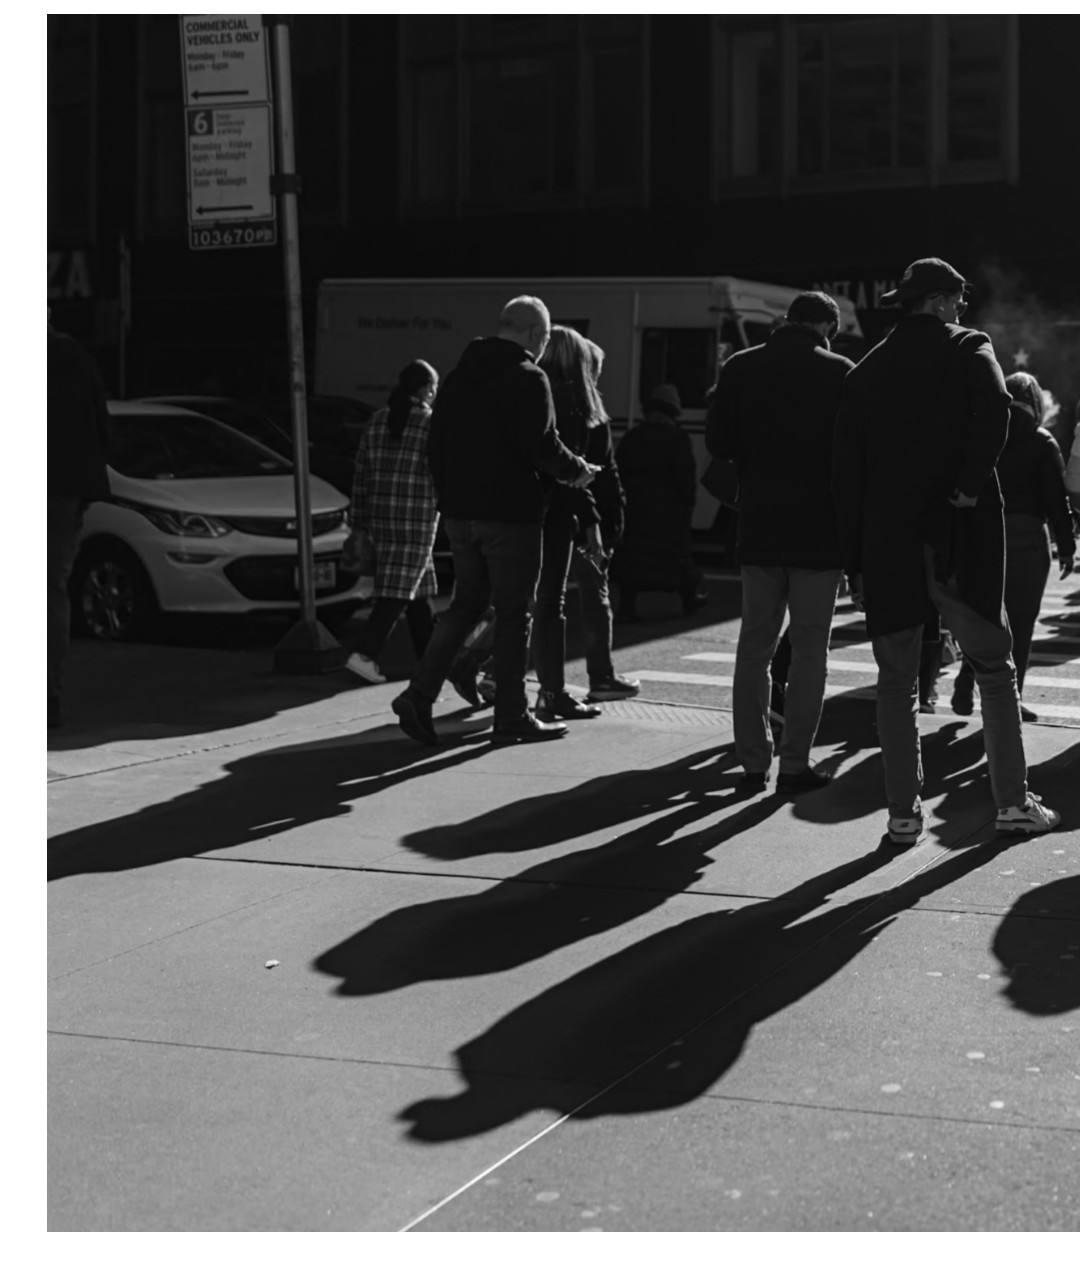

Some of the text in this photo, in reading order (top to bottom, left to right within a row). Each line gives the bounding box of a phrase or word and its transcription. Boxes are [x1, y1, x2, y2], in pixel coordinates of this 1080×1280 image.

[185, 17, 250, 34] COMMERCIAL
[186, 30, 261, 47] VEHICLES ONLY
[195, 111, 208, 134] 6
[192, 228, 254, 246] 103670
